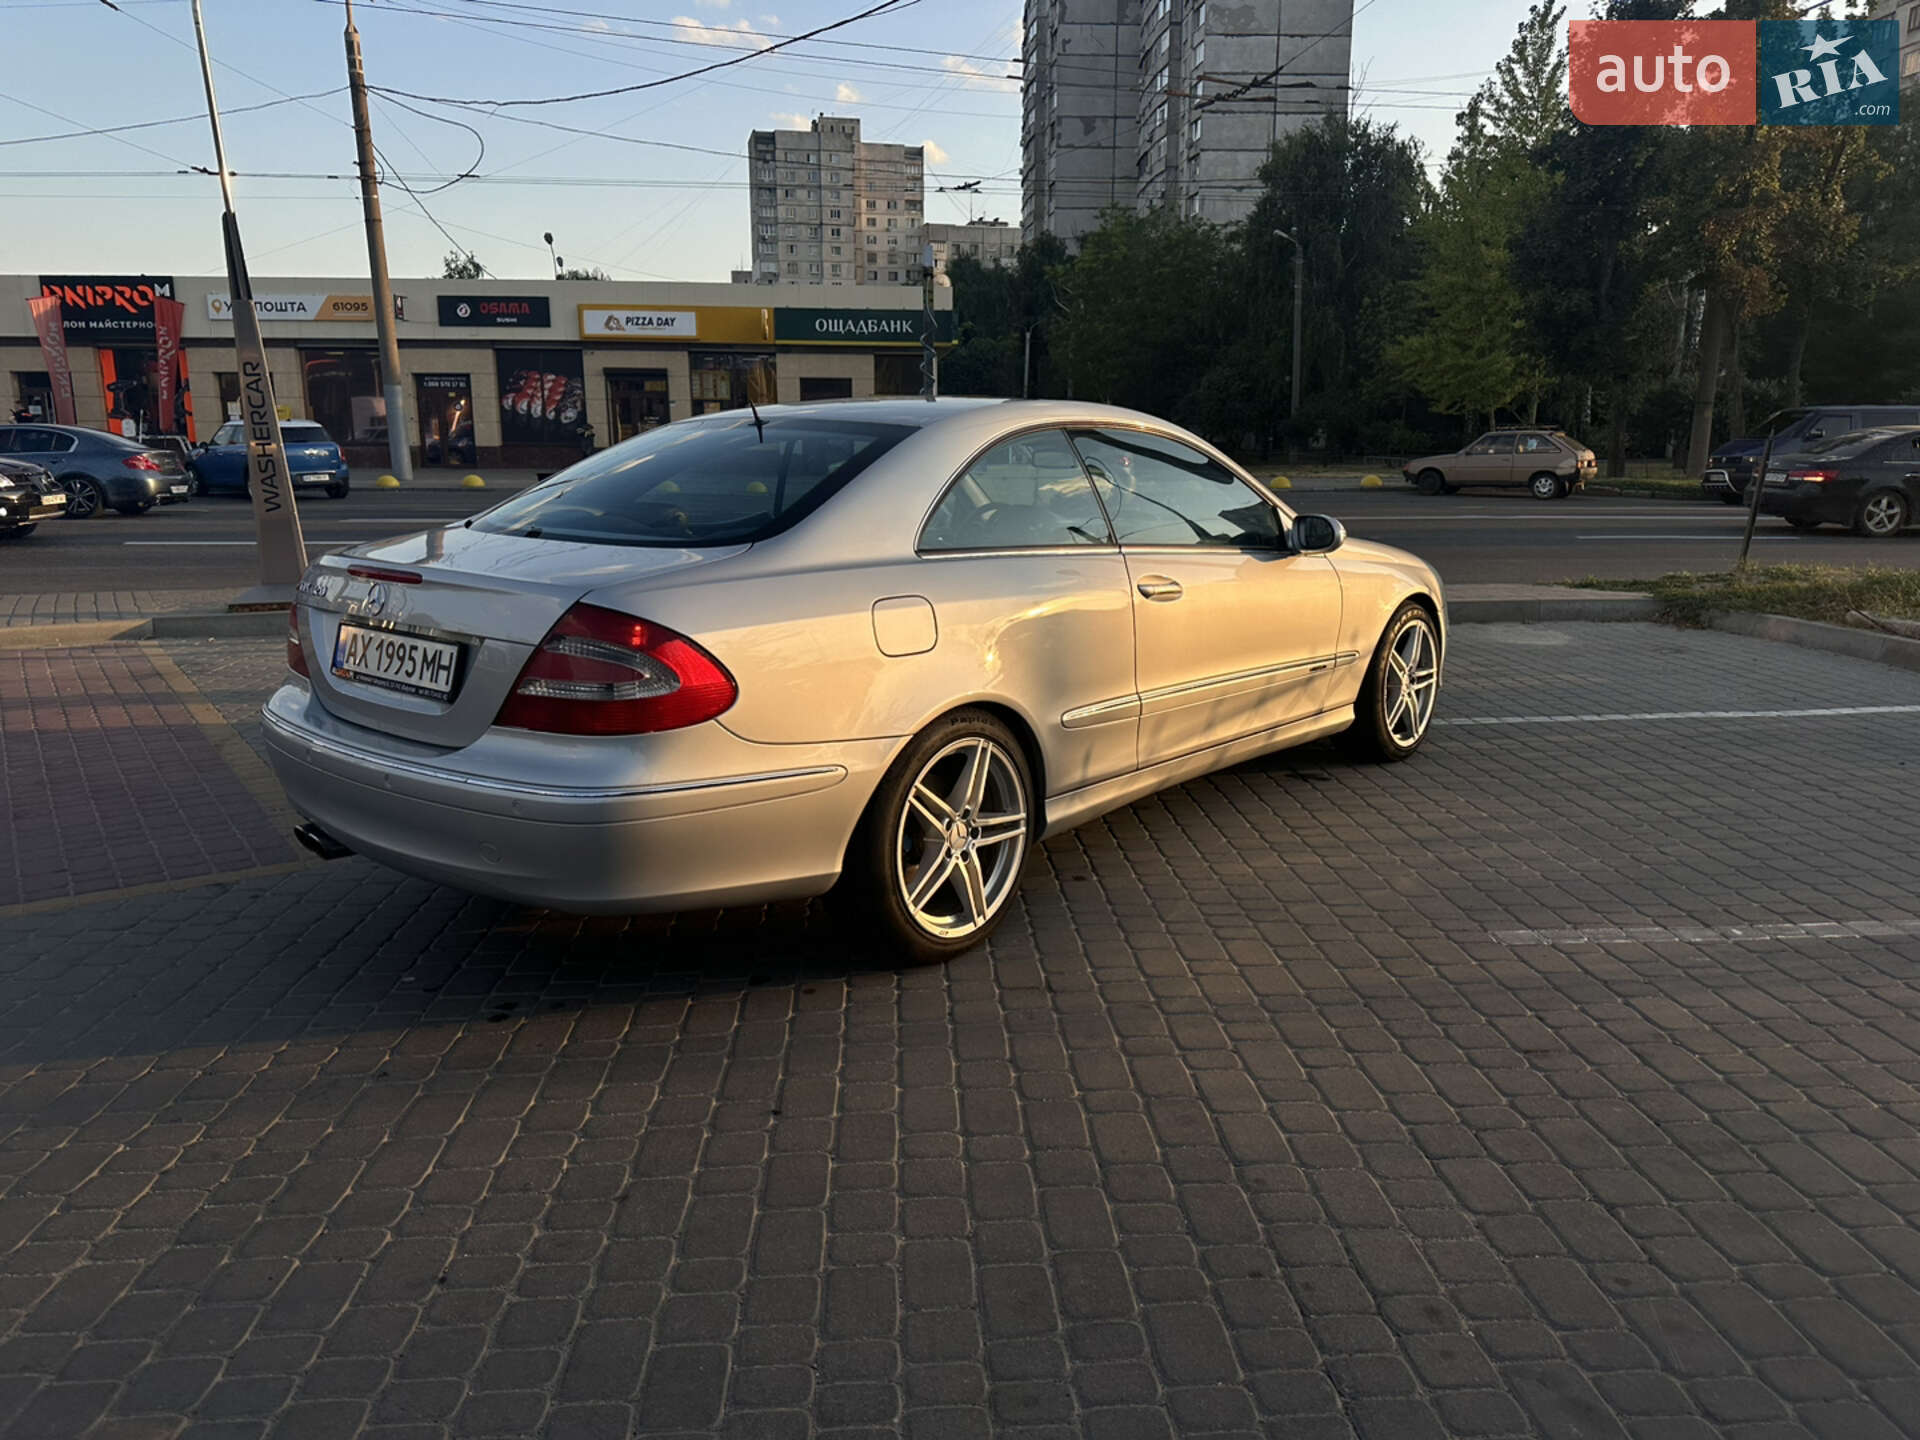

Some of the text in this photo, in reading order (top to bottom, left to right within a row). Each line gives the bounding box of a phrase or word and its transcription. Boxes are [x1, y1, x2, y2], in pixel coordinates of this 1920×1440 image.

[223, 301, 368, 313] УПОШТА 61095
[479, 301, 531, 315] OSAMA
[63, 319, 156, 329] ЛОН МАЙСТЕРНО
[625, 316, 654, 327] PIZZA
[656, 316, 676, 328] DAY
[815, 318, 913, 335] ОЩАДБАНК
[243, 361, 281, 513] WASHERCAR
[345, 633, 373, 669] AX
[376, 638, 419, 678] 1995
[419, 646, 454, 687] MH
